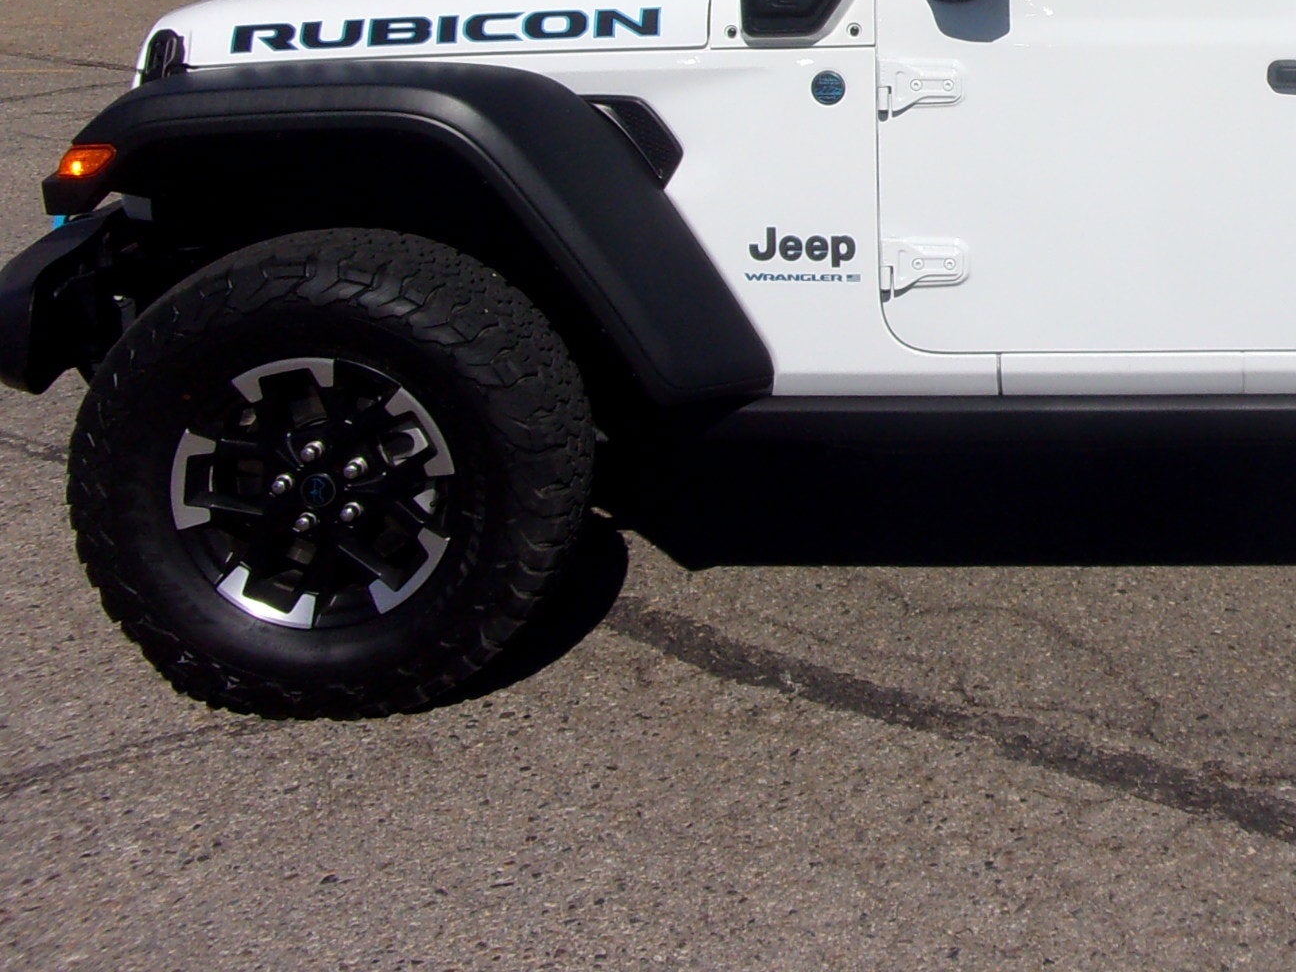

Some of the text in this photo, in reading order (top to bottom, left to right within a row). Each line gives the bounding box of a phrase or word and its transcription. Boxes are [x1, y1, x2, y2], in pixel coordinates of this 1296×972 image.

[231, 7, 662, 54] RUBICON
[748, 226, 856, 268] Jeep
[744, 272, 843, 282] WRANGLER
